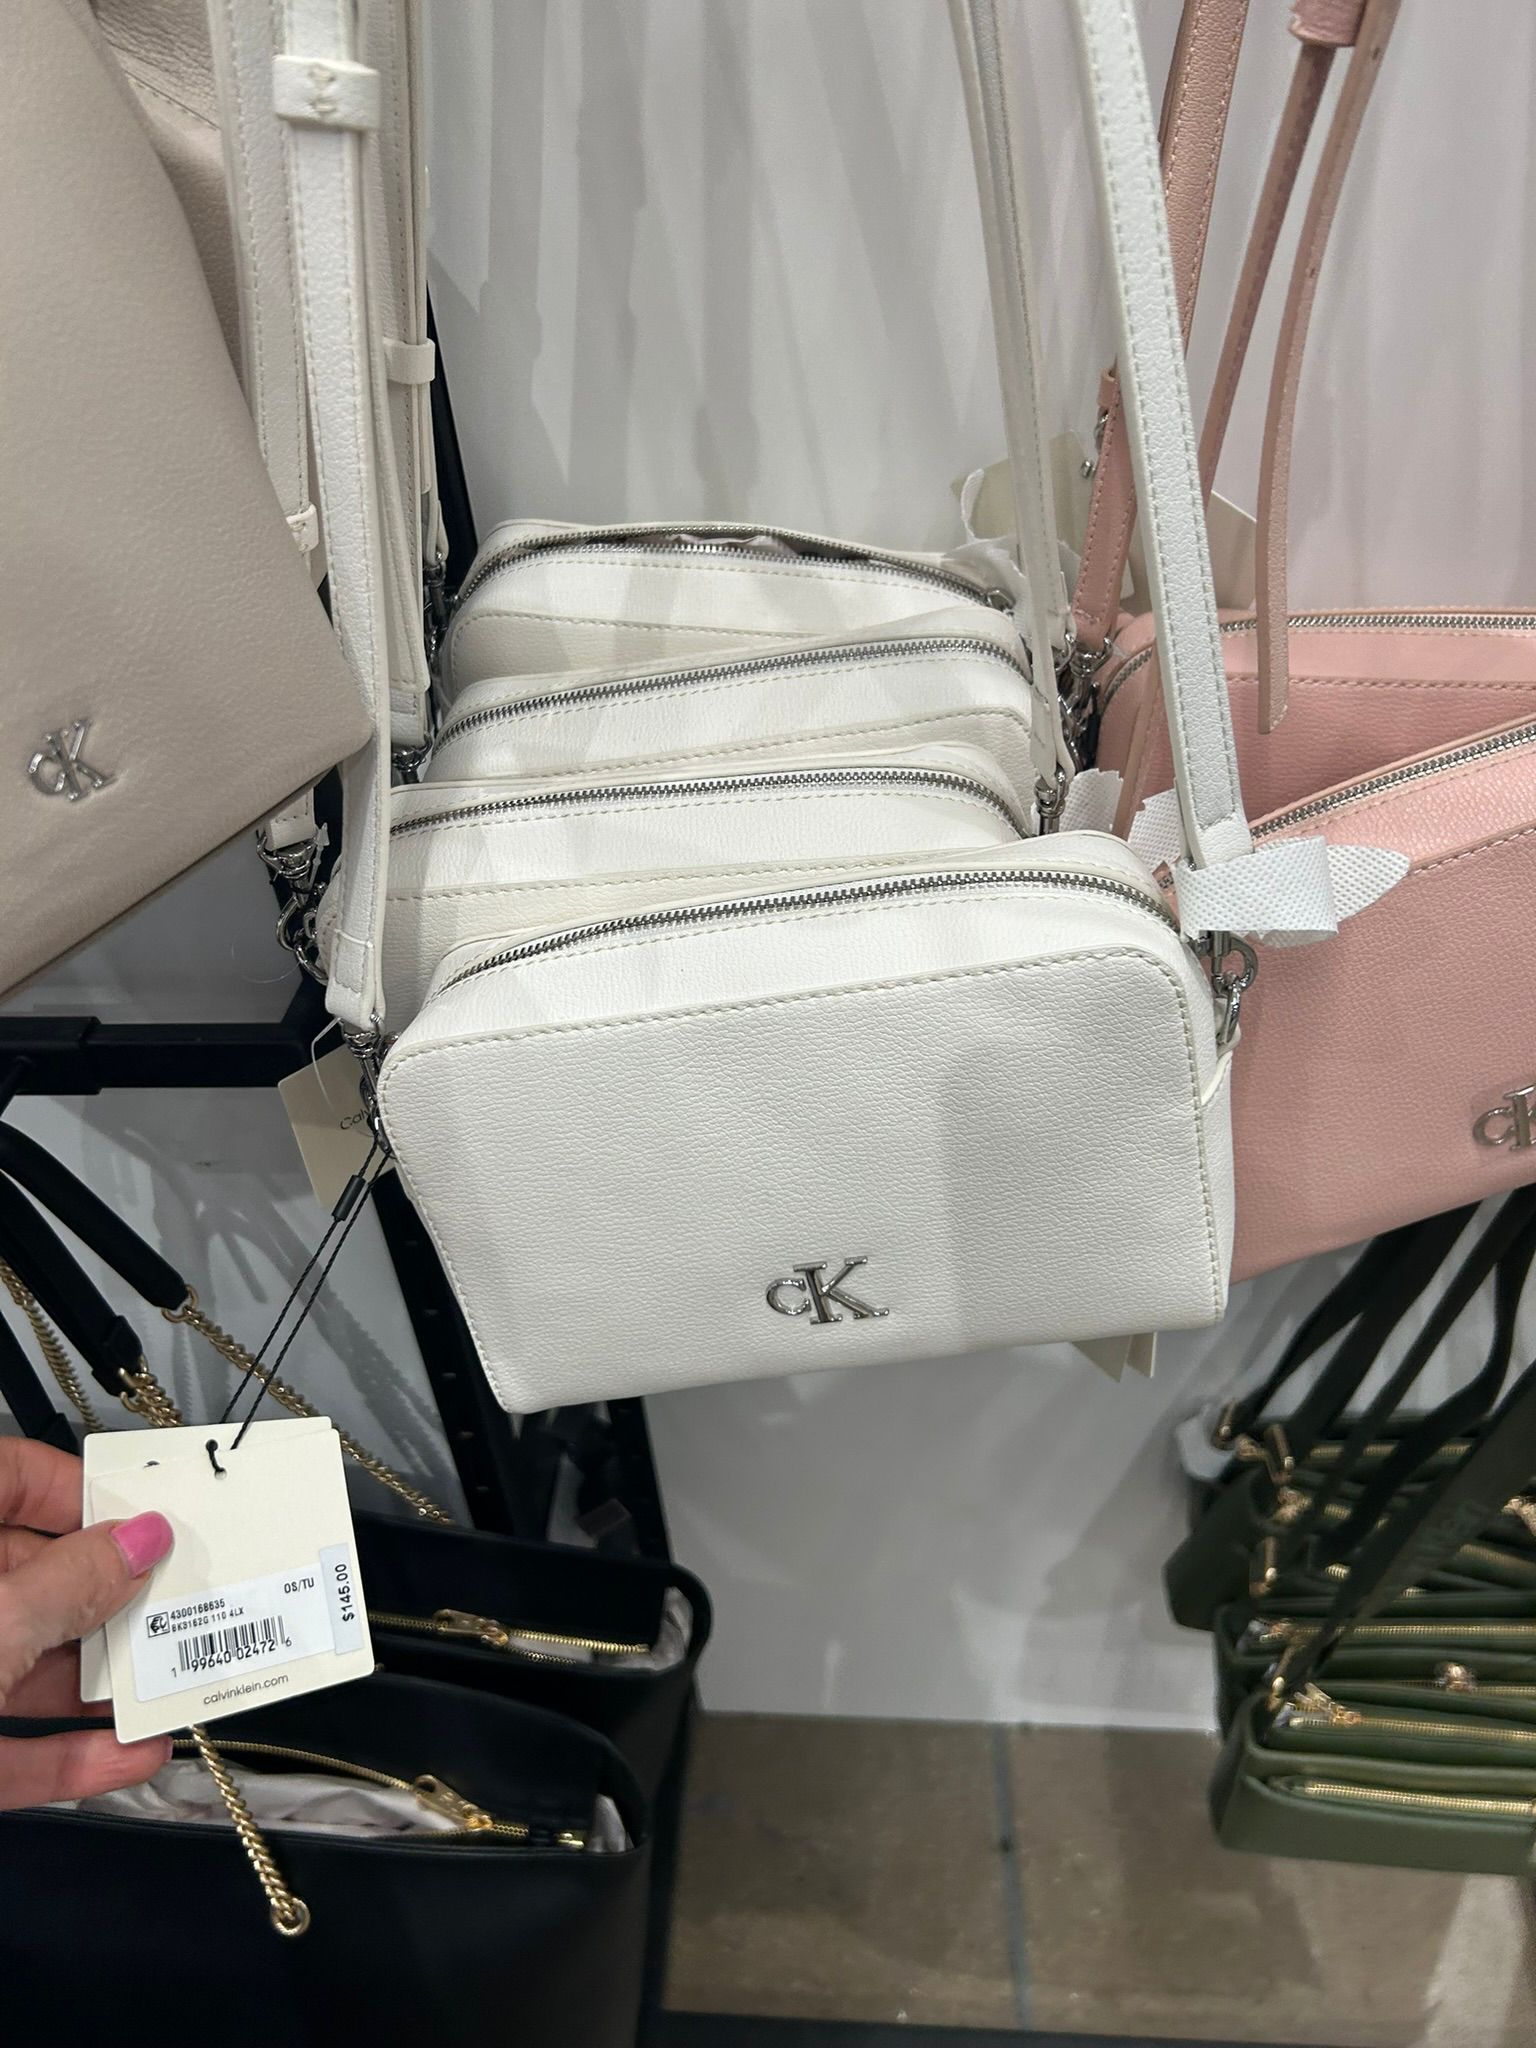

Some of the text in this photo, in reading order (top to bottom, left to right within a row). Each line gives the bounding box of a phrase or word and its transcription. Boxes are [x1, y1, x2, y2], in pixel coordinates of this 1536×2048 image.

[284, 1577, 315, 1594] OS/TU
[335, 1564, 355, 1622] $145.00
[171, 1637, 292, 1678] 1 99640 02472 6
[203, 1674, 289, 1705] calvinklein.com
